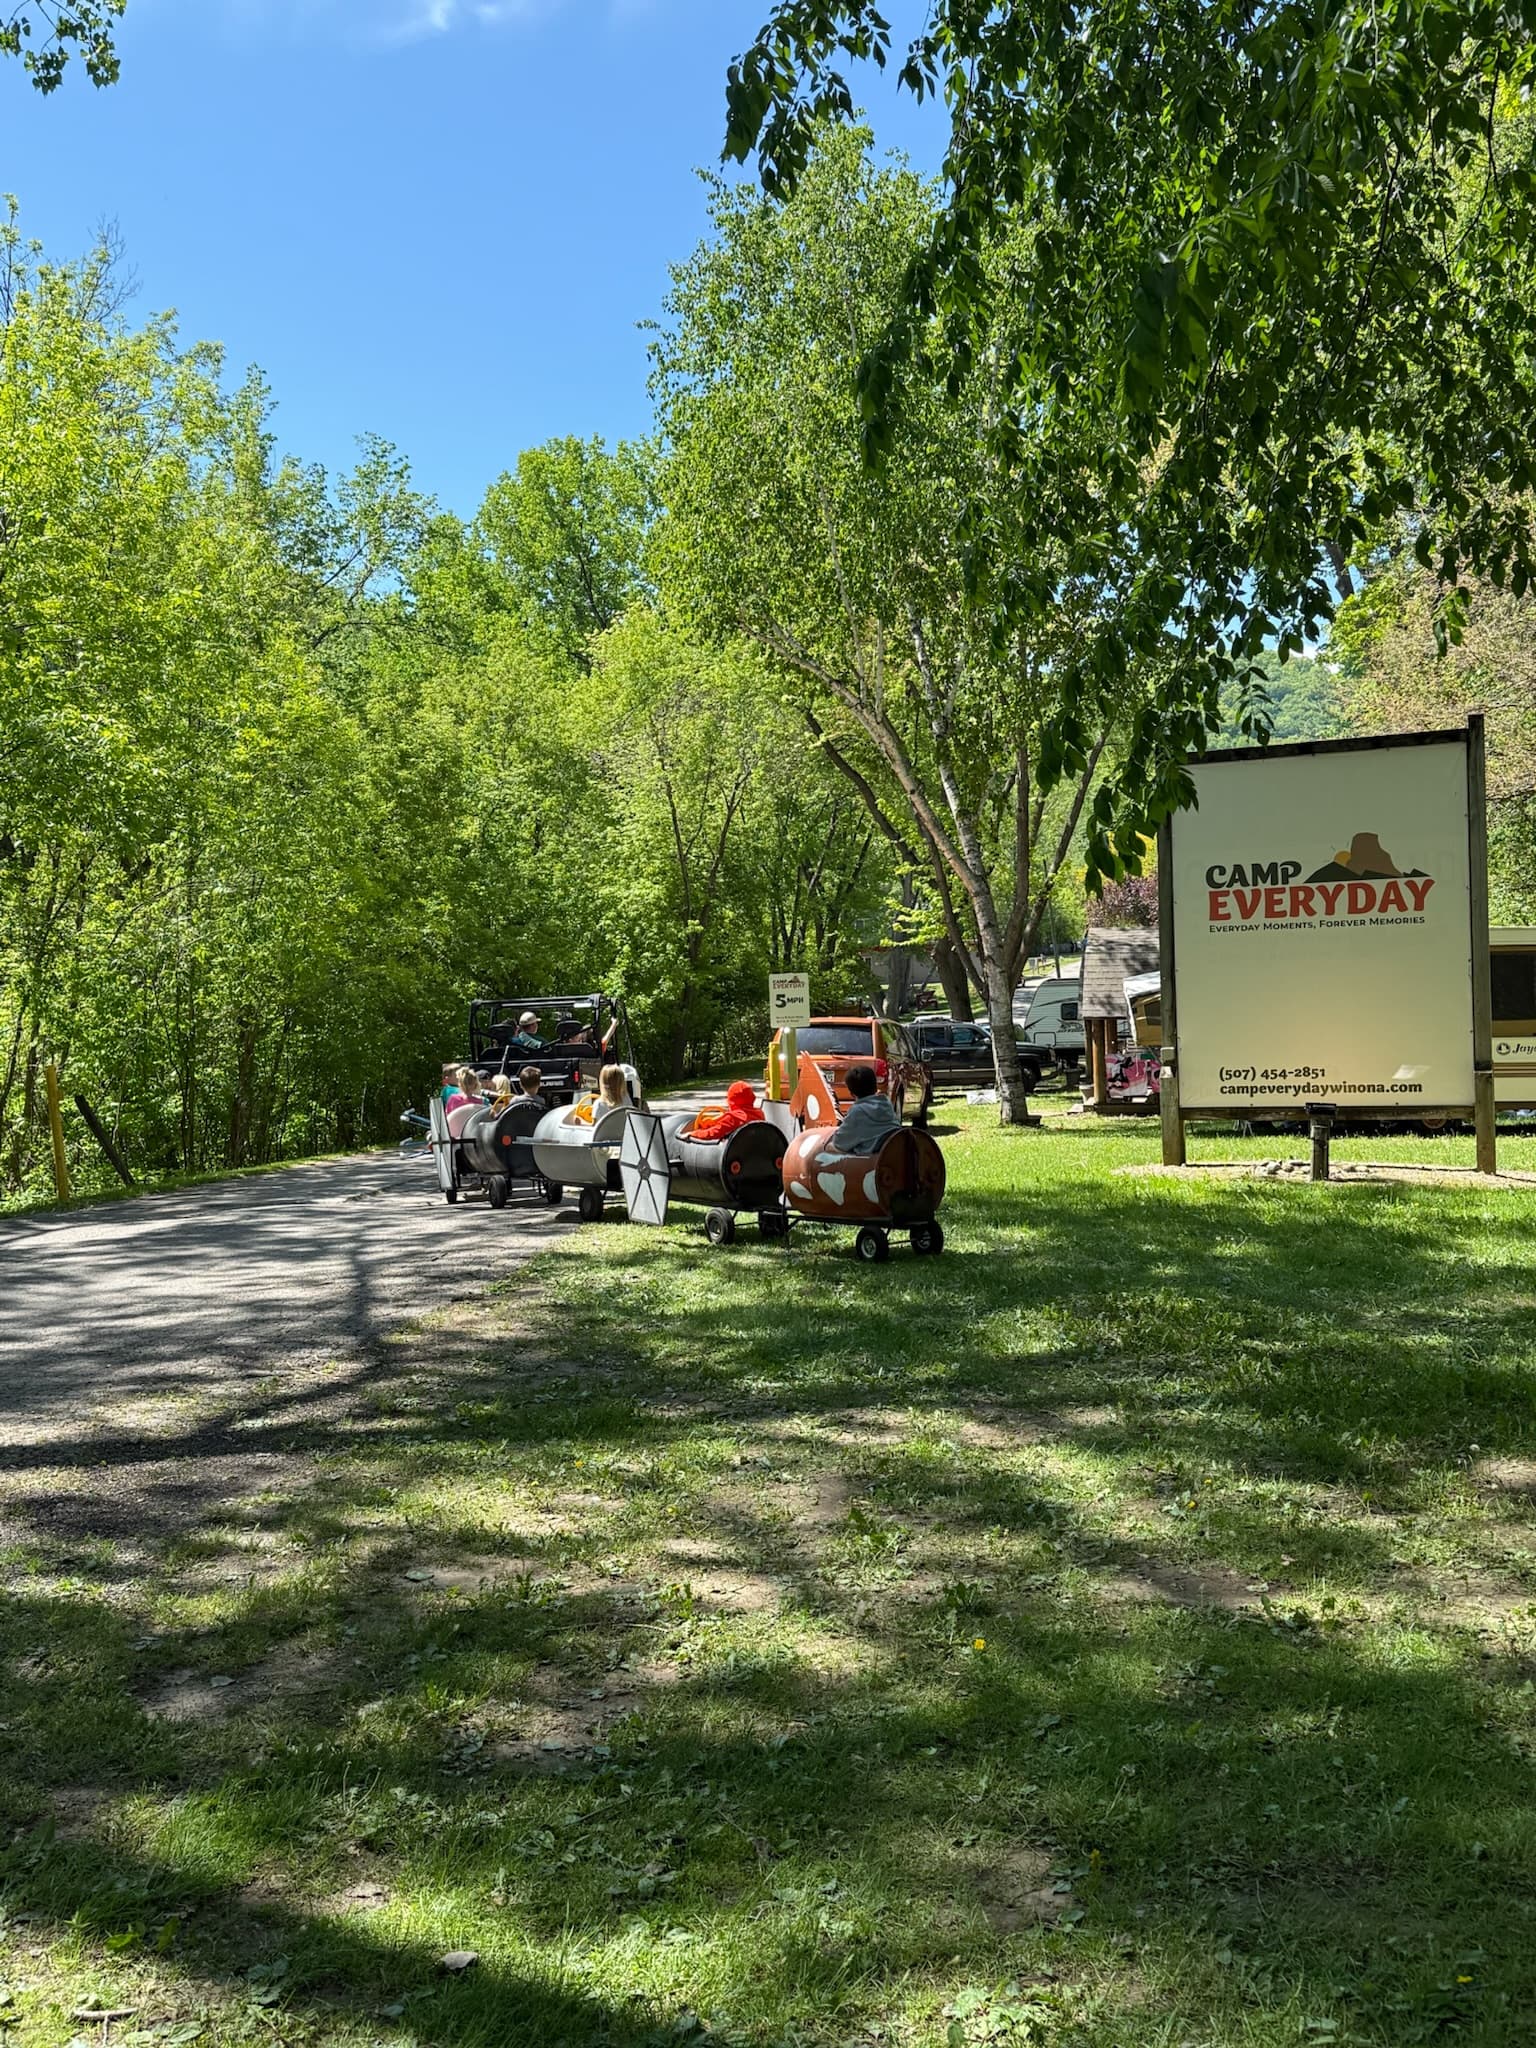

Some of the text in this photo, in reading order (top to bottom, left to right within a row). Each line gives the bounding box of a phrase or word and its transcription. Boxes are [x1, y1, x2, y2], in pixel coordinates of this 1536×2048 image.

[1205, 860, 1303, 889] CAMP
[1208, 879, 1436, 922] EVERYDAY
[775, 994, 787, 1008] 5
[1219, 1066, 1326, 1081] (507) 454-2851
[1219, 1081, 1423, 1097] campeverydaywinona.com
